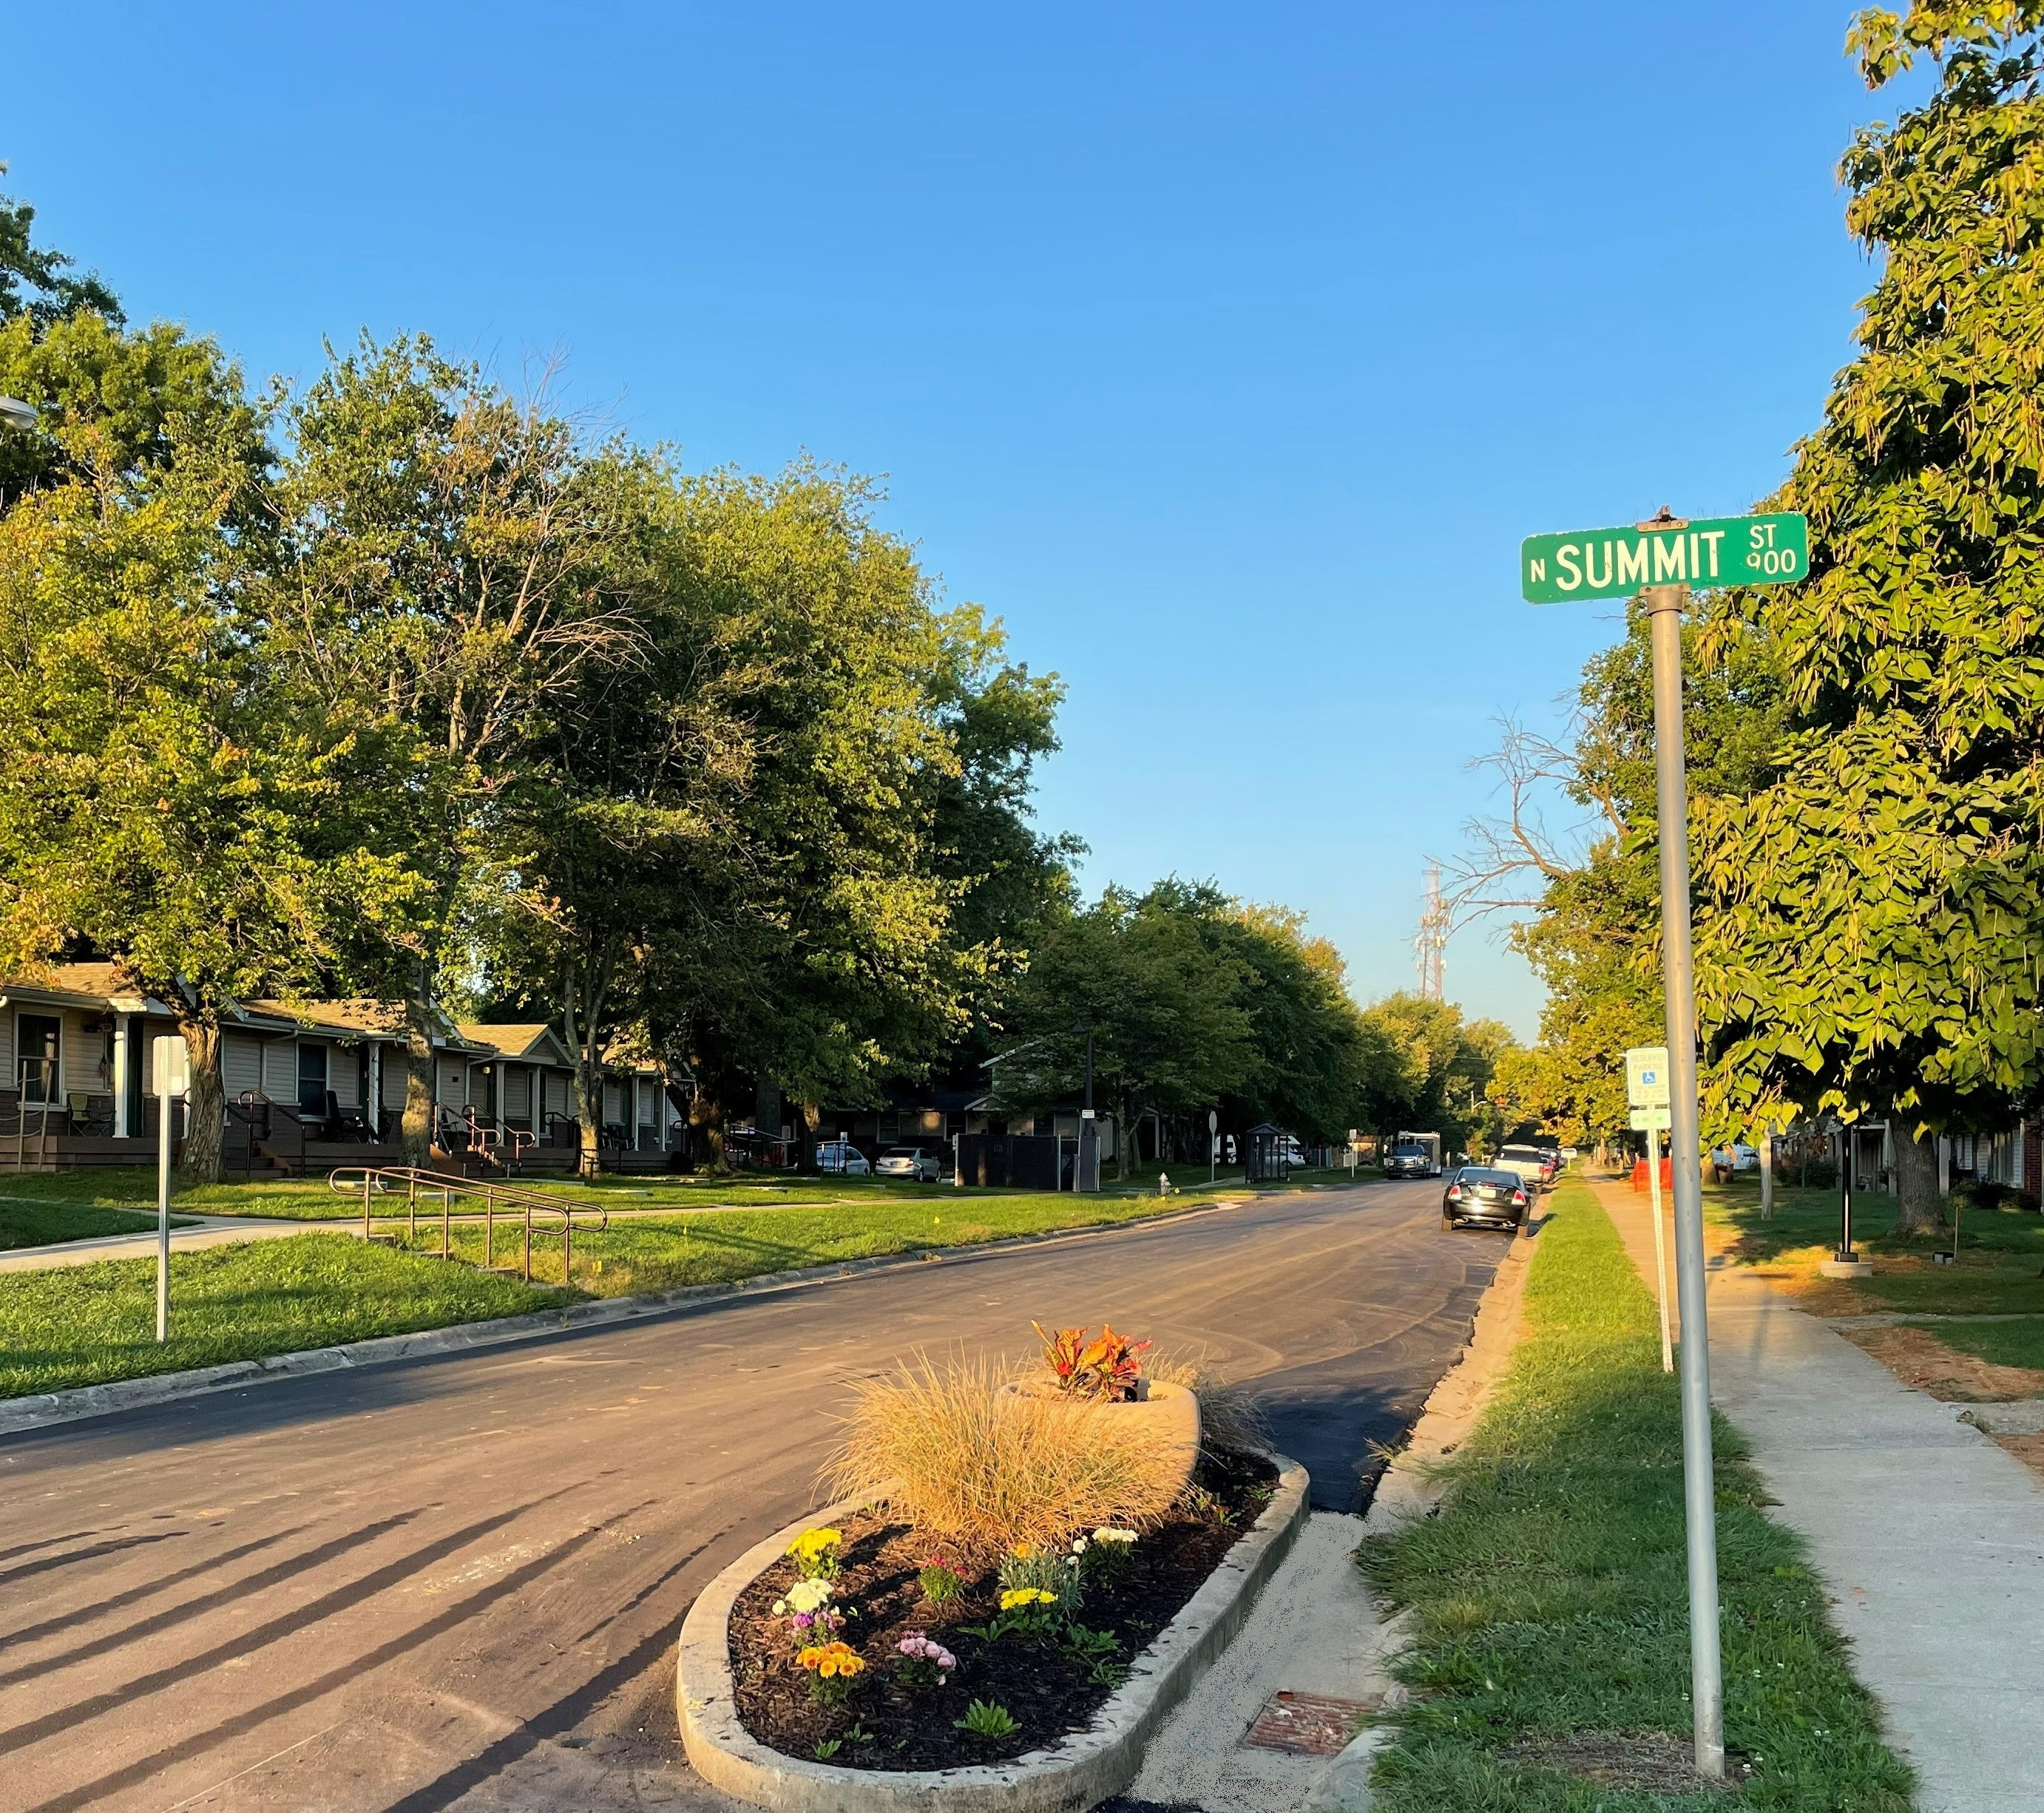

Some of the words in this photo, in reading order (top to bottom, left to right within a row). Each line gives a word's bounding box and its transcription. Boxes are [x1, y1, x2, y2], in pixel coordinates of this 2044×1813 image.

[1531, 558, 1546, 583] N
[1556, 530, 1725, 591] SUMMIT
[1750, 523, 1777, 549] ST
[1747, 549, 1796, 575] 900
